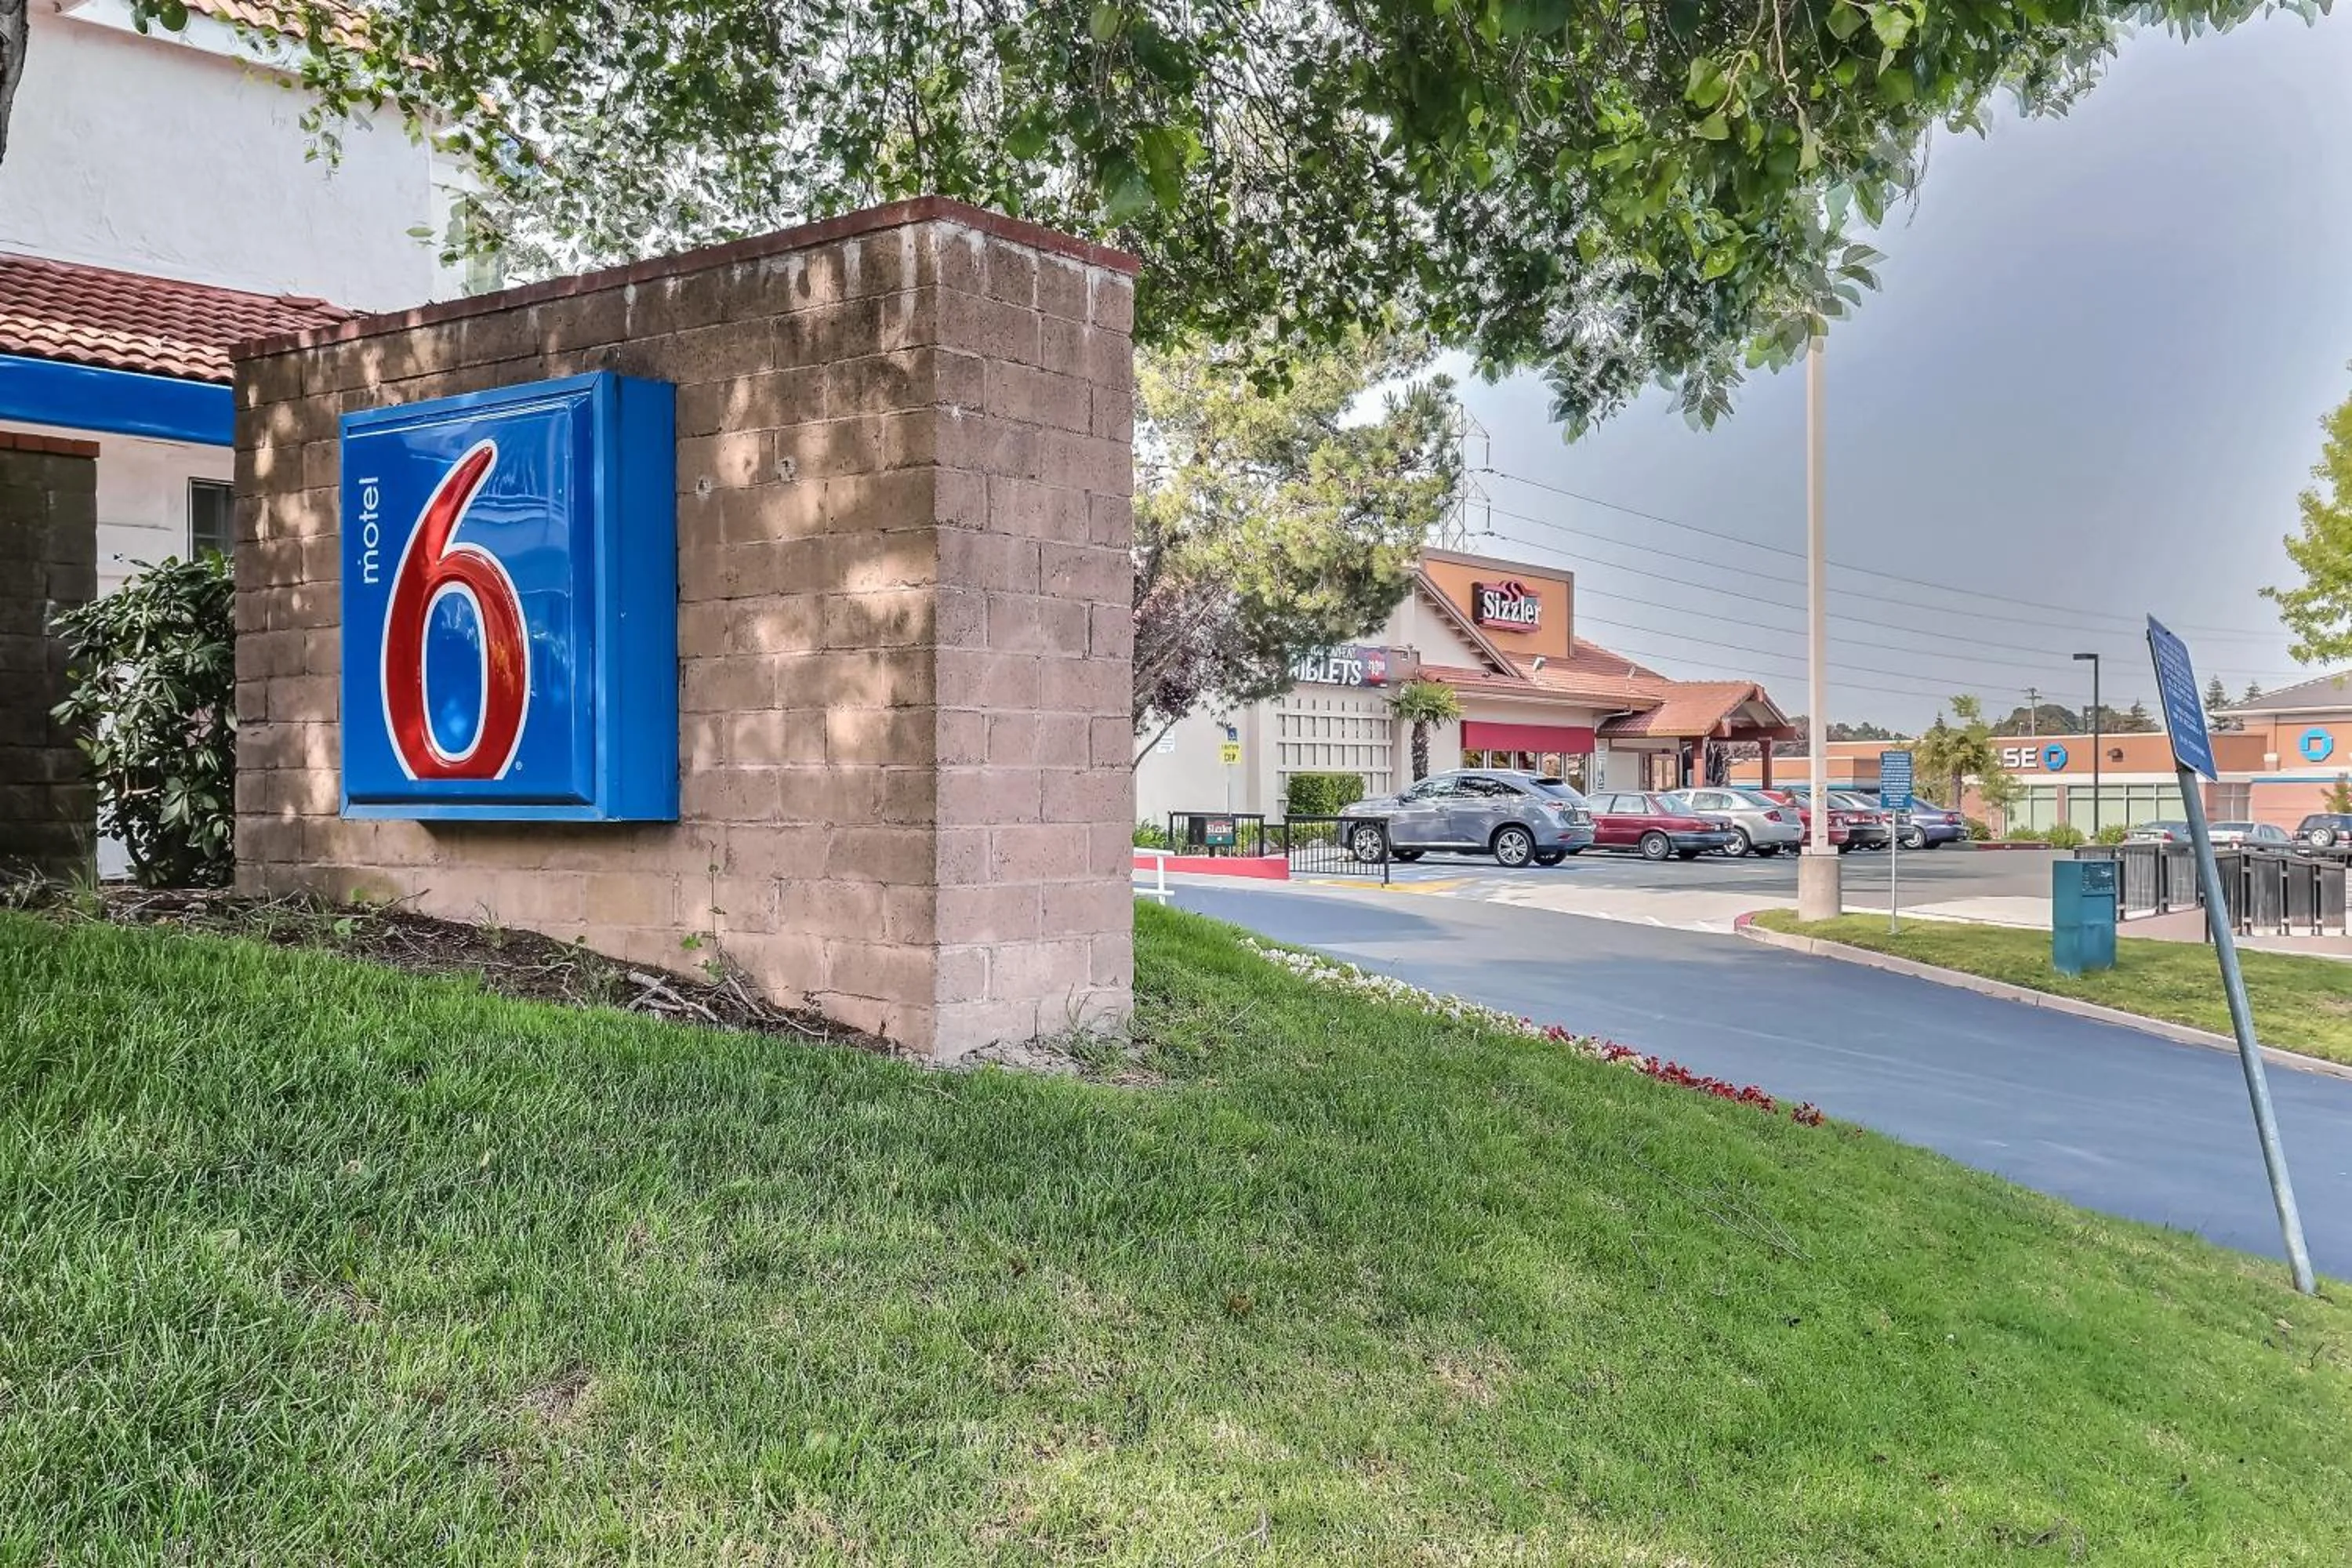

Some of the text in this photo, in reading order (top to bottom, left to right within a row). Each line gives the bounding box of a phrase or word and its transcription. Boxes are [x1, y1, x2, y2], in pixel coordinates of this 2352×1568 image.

[358, 438, 530, 780] motel 6
[1483, 590, 1543, 625] Sizzler
